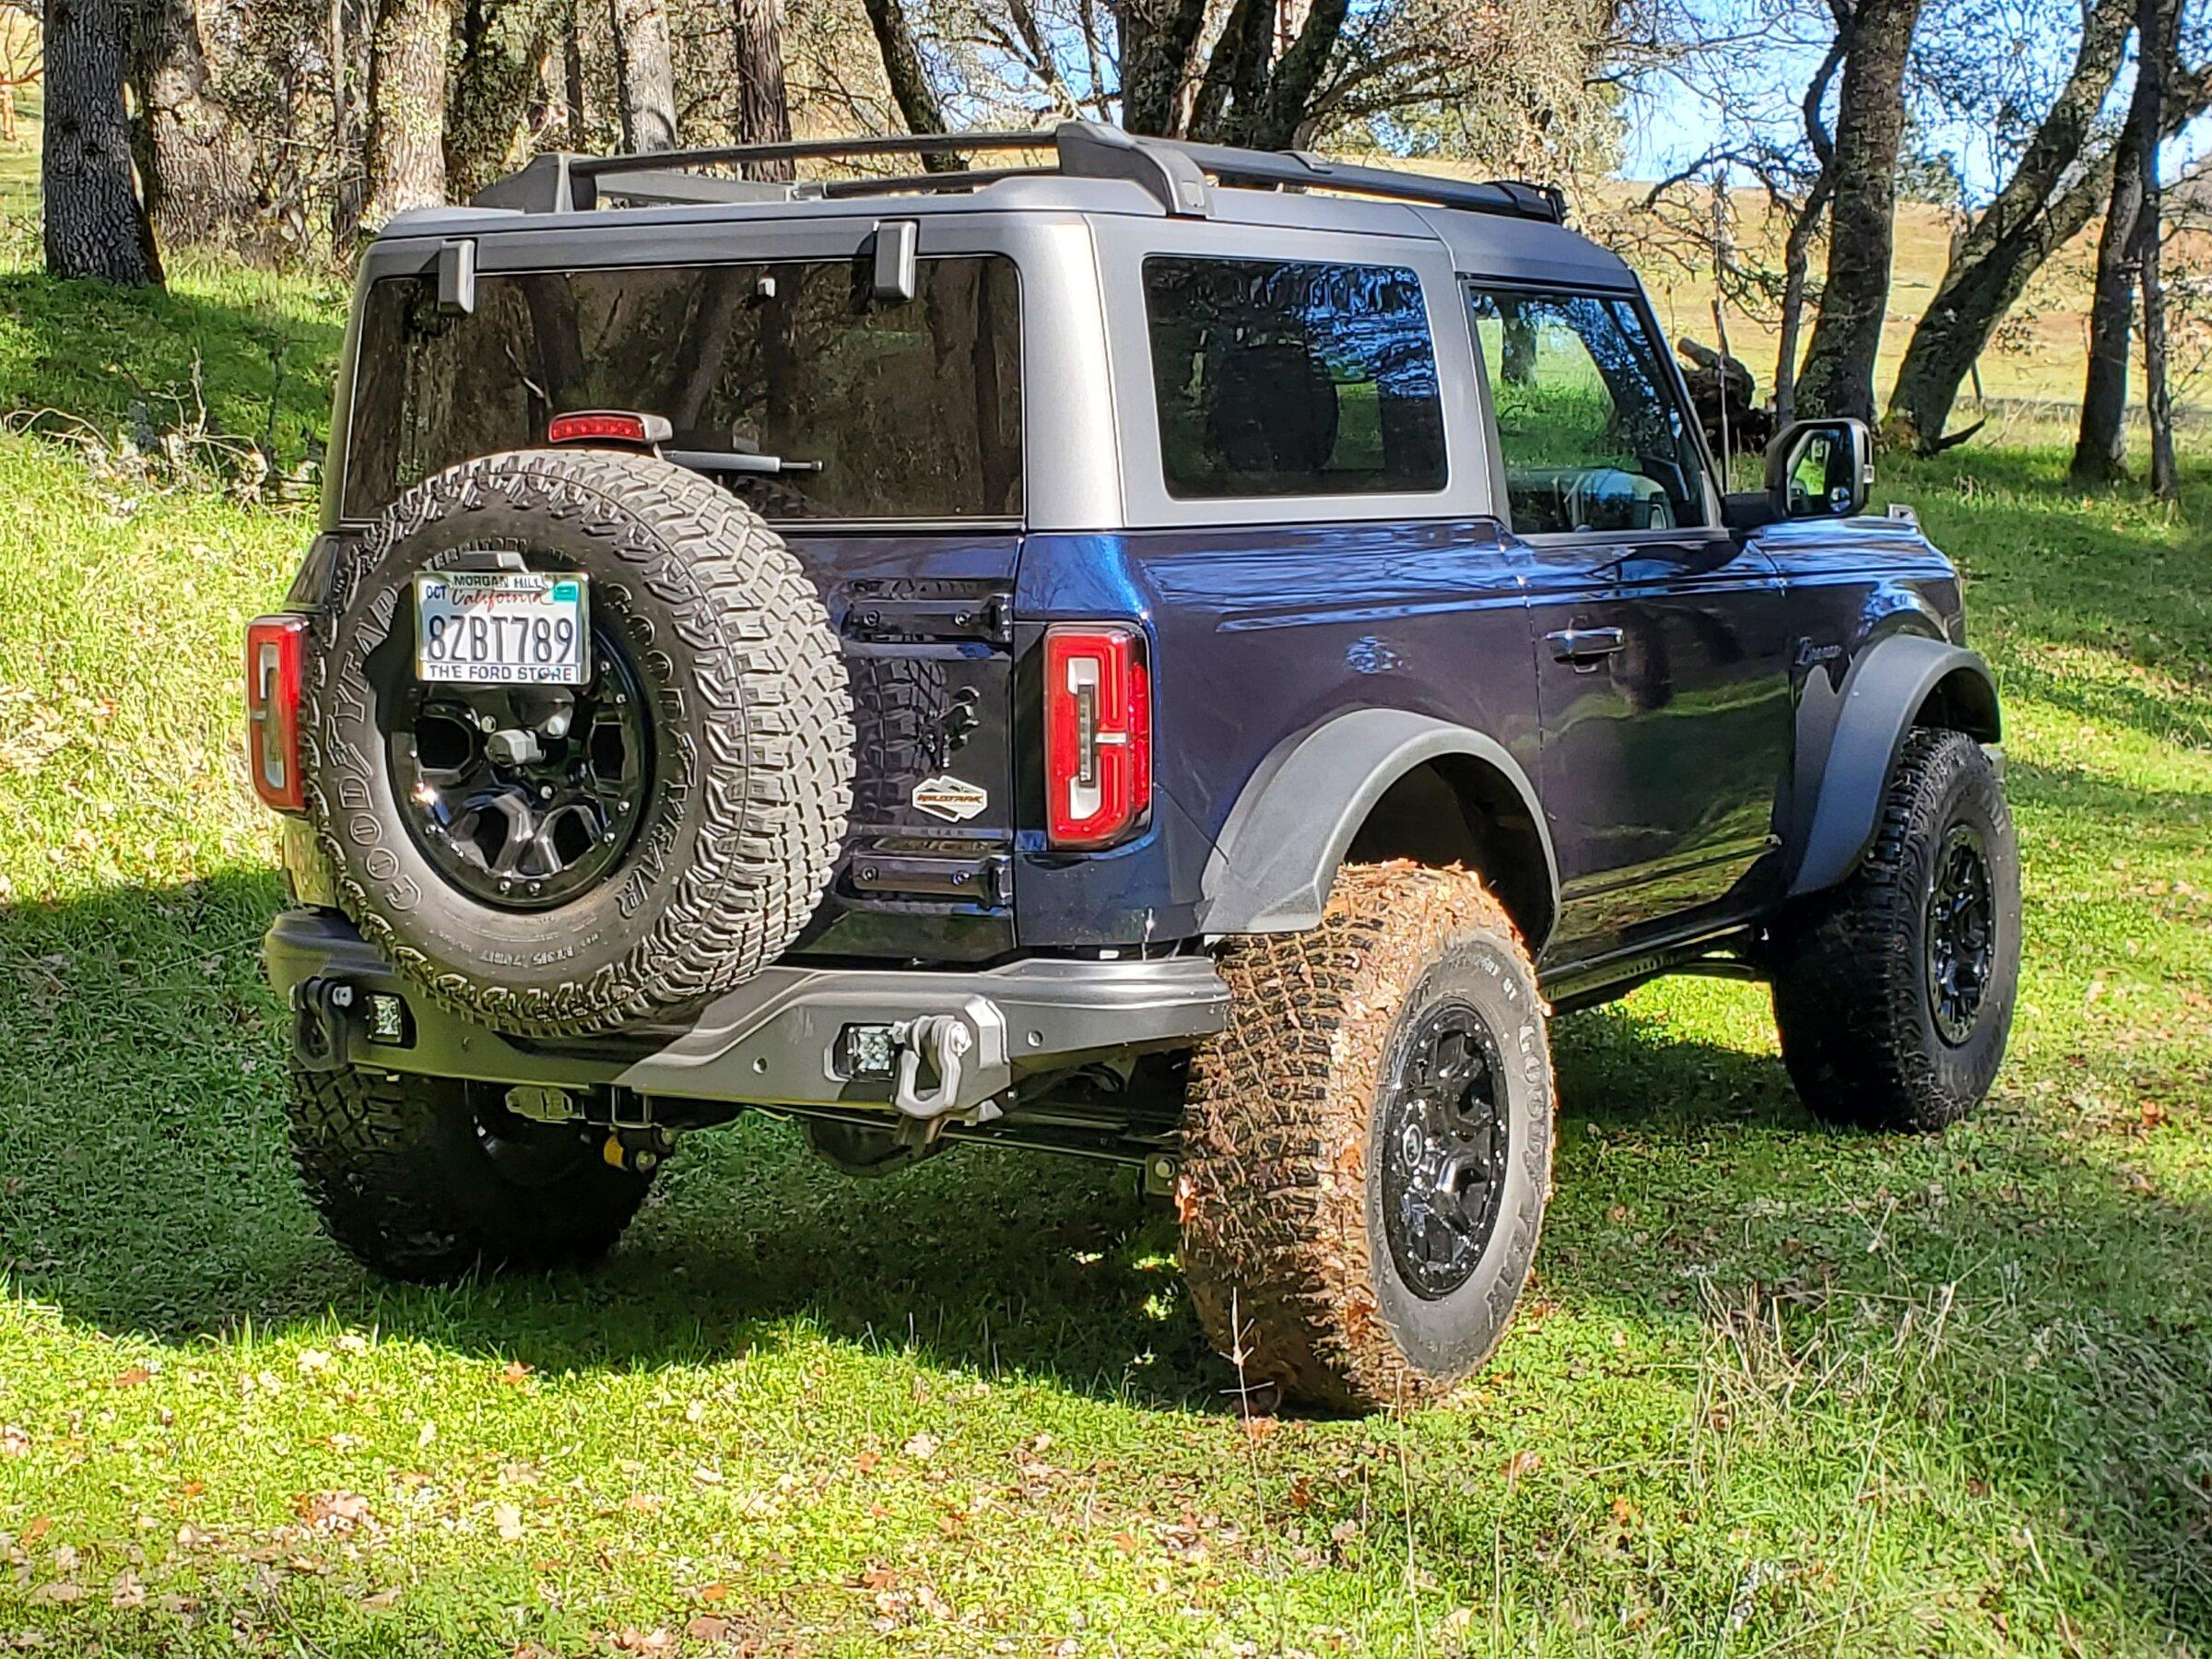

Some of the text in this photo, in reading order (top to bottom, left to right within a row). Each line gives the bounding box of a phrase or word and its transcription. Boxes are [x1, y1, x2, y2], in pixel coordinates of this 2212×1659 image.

[453, 574, 541, 589] MORGAN HILL
[425, 584, 448, 600] OCT
[451, 588, 554, 612] California
[428, 614, 574, 664] 8ZBT789
[429, 665, 572, 682] THE FORD STORE
